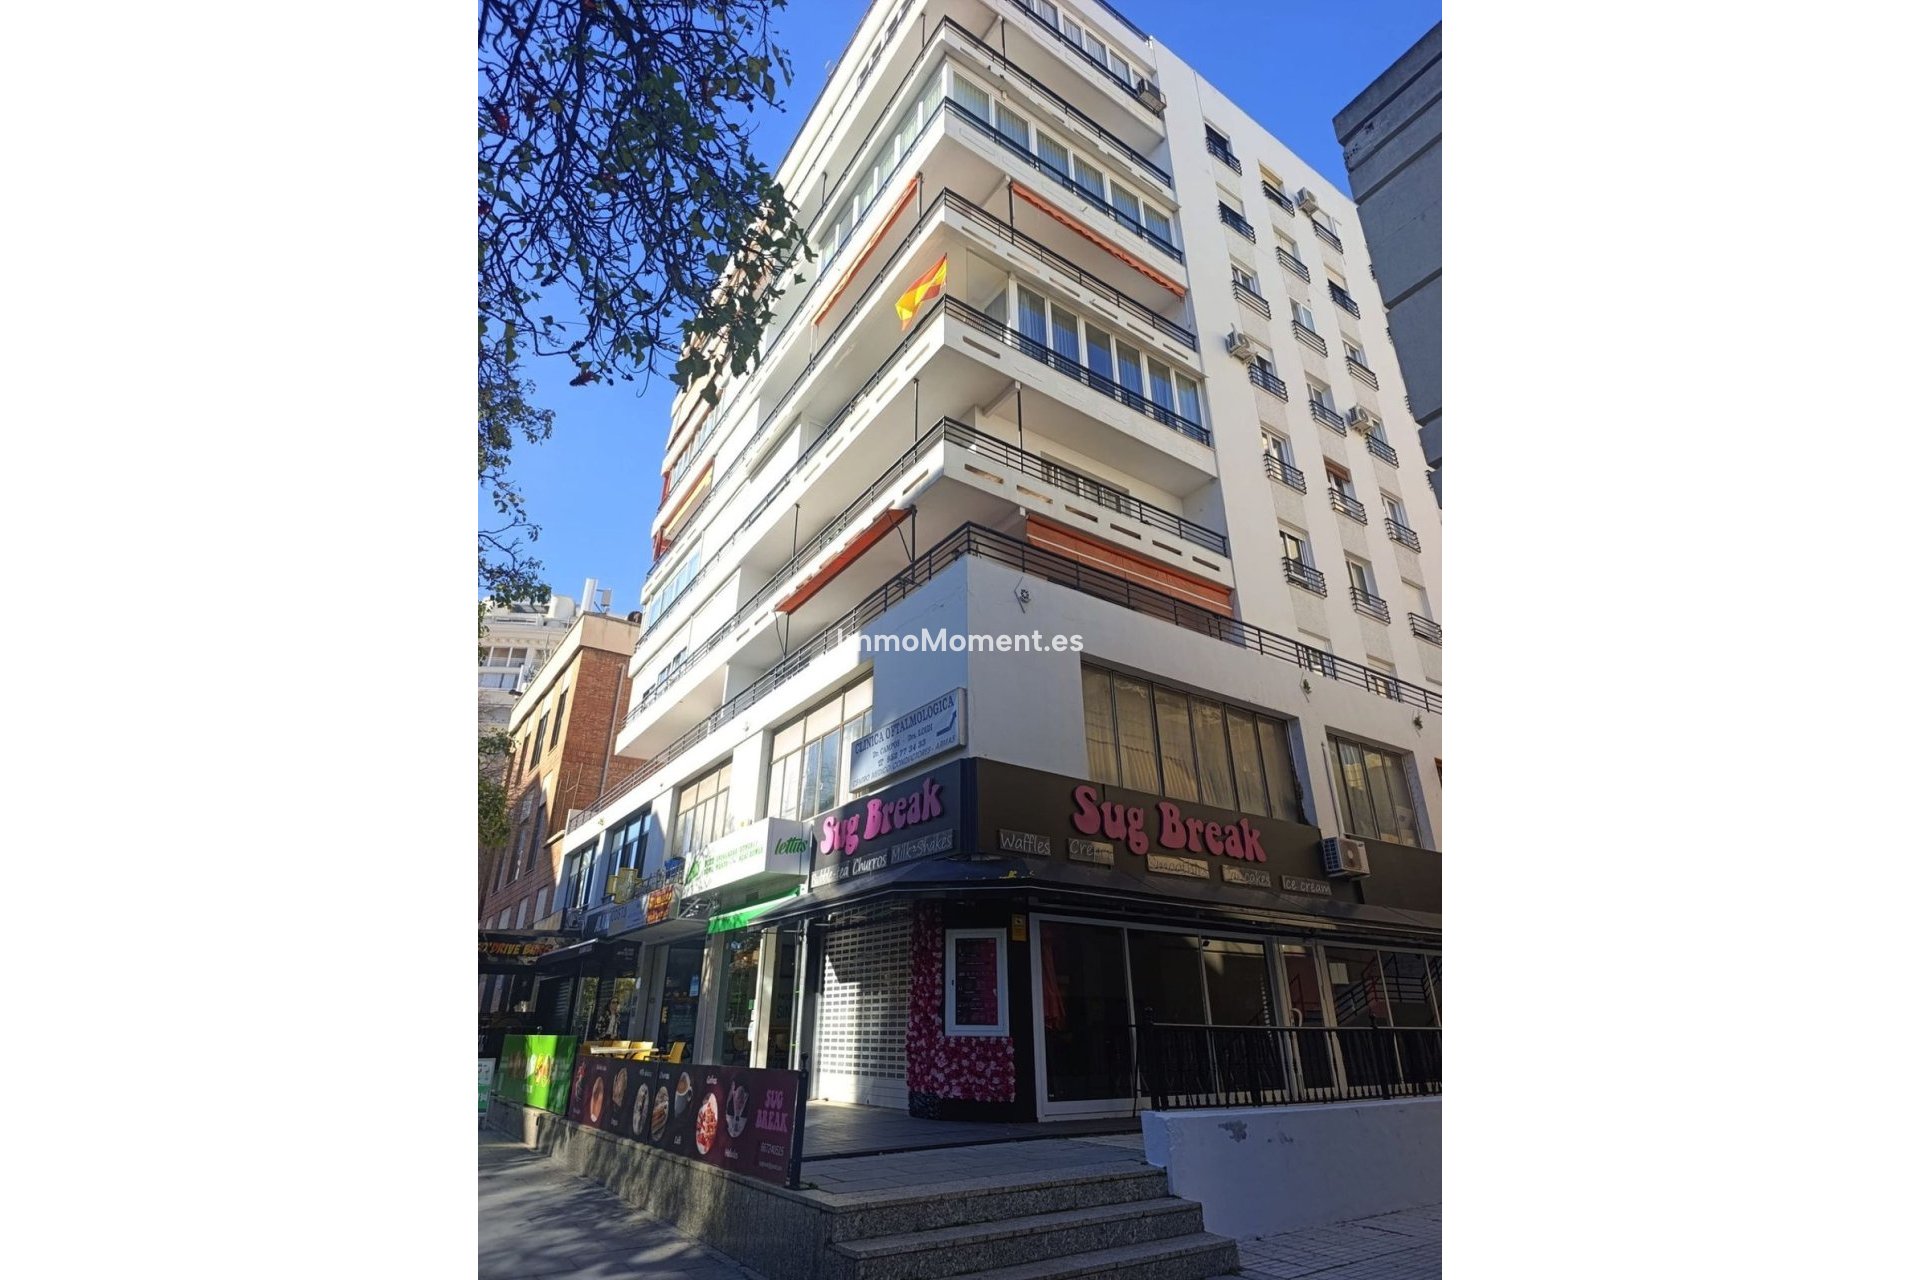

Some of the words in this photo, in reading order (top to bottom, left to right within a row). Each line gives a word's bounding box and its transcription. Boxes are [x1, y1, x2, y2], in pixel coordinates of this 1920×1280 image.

[855, 734, 884, 754] CLINICA
[885, 695, 955, 740] OFTALMOLOGICA
[820, 813, 860, 856] Sug
[864, 777, 942, 841] Break
[1072, 784, 1150, 855] Sug
[1156, 801, 1268, 863] Break
[999, 832, 1052, 856] Waffles
[852, 853, 887, 876] Churros
[1300, 881, 1332, 895] cream
[764, 1089, 784, 1110] SUG
[755, 1108, 789, 1133] BREAK
